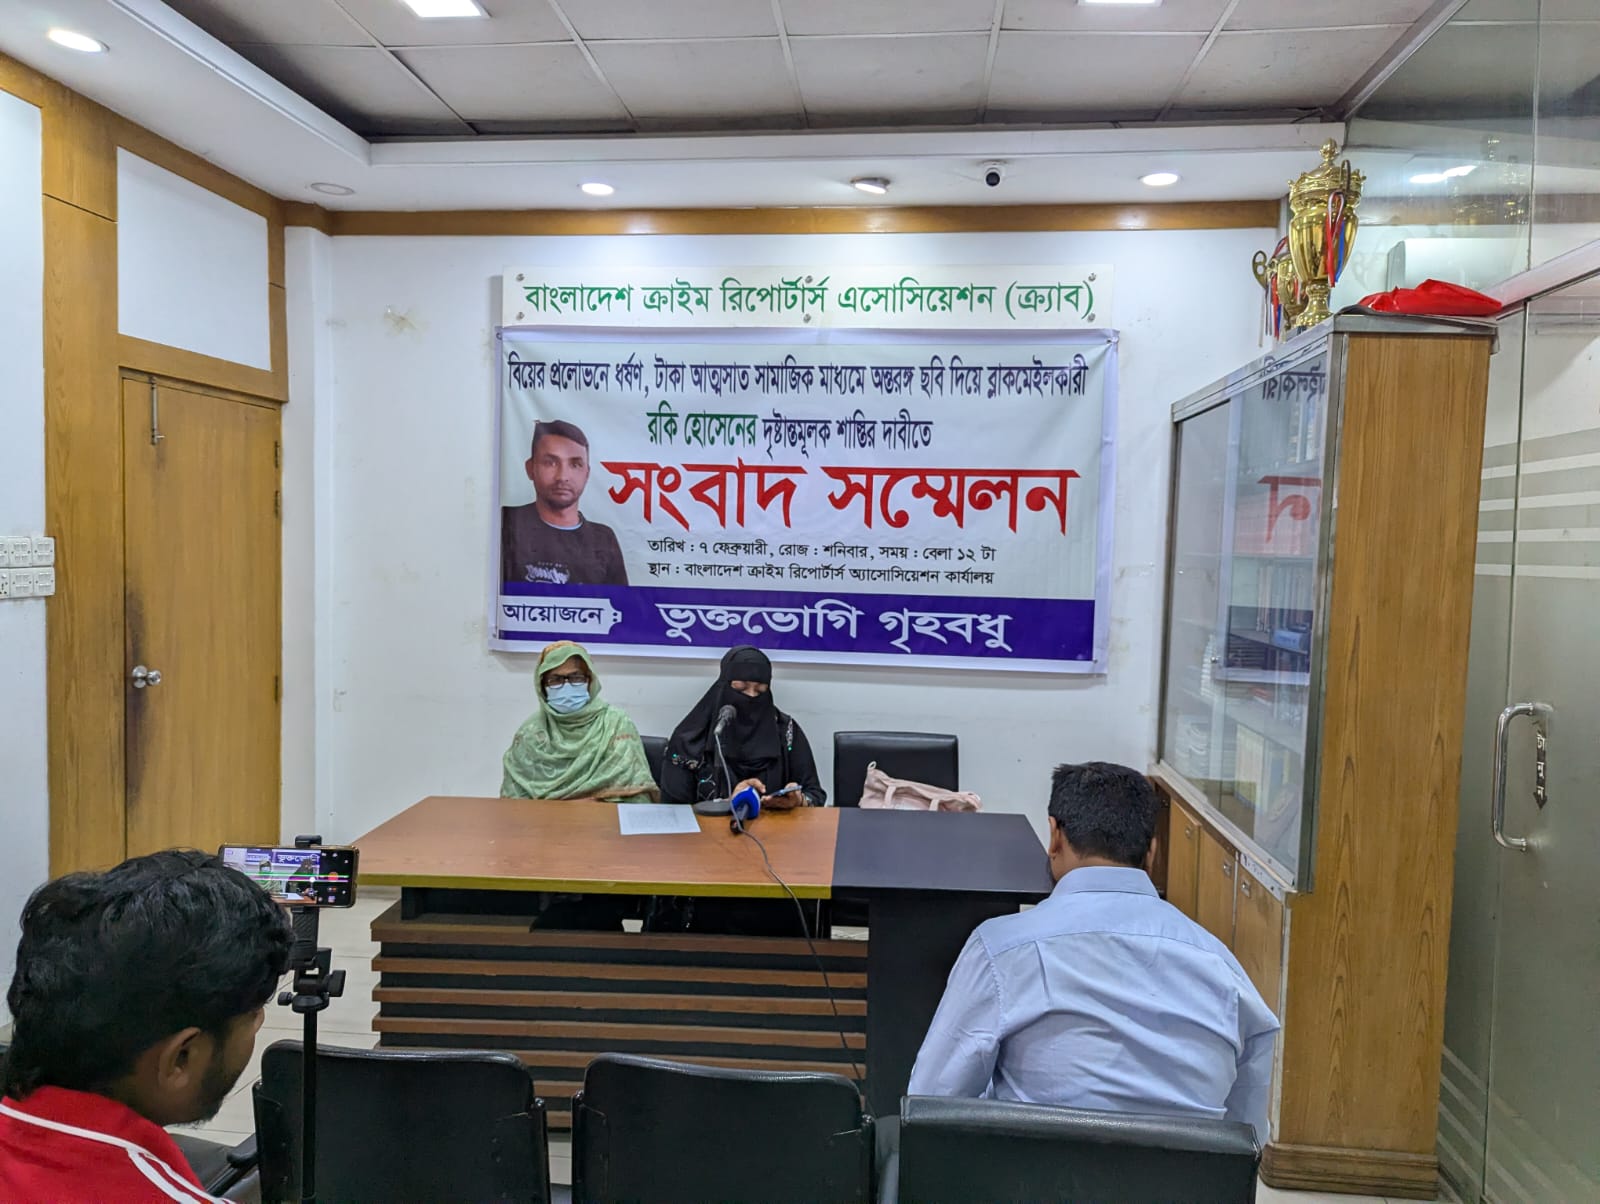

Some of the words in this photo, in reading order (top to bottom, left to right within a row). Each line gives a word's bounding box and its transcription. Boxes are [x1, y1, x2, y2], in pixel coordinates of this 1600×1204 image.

[523, 282, 634, 314] বাংলাদেশ
[641, 276, 713, 315] ক্রাইম
[719, 275, 830, 314] রিপোর্টার্স
[837, 275, 997, 313] এসোসিয়েশন
[1004, 279, 1094, 320] (ক্র্যাব)
[507, 350, 546, 392] বিয়ের
[550, 357, 610, 393] প্রলোভনে
[615, 352, 649, 399] ধর্ষণ,
[654, 354, 686, 393] টাকা
[690, 360, 751, 398] আত্মসাত
[754, 353, 815, 396] সামাজিক
[818, 362, 867, 396] মাধ্যমে
[870, 364, 915, 396] অন্তরঙ্গ
[919, 354, 946, 399] ছবি
[949, 354, 984, 396] দিয়ে
[986, 352, 1089, 400] ব্লাকমেইলকারী
[646, 399, 679, 446] রকি
[684, 409, 758, 448] হোসেনের
[762, 408, 832, 459] দৃষ্টান্তমূলক
[836, 408, 878, 449] শাস্তির
[881, 407, 934, 451] দাবীতে
[600, 456, 807, 532] সংবাদ
[820, 466, 1081, 537] সম্মেলন
[647, 536, 686, 553] তারিখ
[699, 542, 708, 554] ৭
[779, 543, 809, 557] রোজ
[879, 546, 909, 559] সময়
[923, 547, 952, 561] বেলা
[957, 548, 976, 563] ১২
[981, 545, 996, 562] টা
[647, 562, 671, 577] স্থান
[684, 563, 744, 577] বাংলাদেশ
[747, 562, 784, 578] ক্রাইম
[789, 563, 846, 581] রিপোর্টার্স
[849, 565, 940, 584] অ্যাসোসিয়েশন
[944, 566, 995, 585] কার্যালয়
[503, 604, 604, 624] আয়োজনে
[655, 599, 865, 643] ভুক্তভোগি
[878, 607, 1013, 653] গৃহবধু
